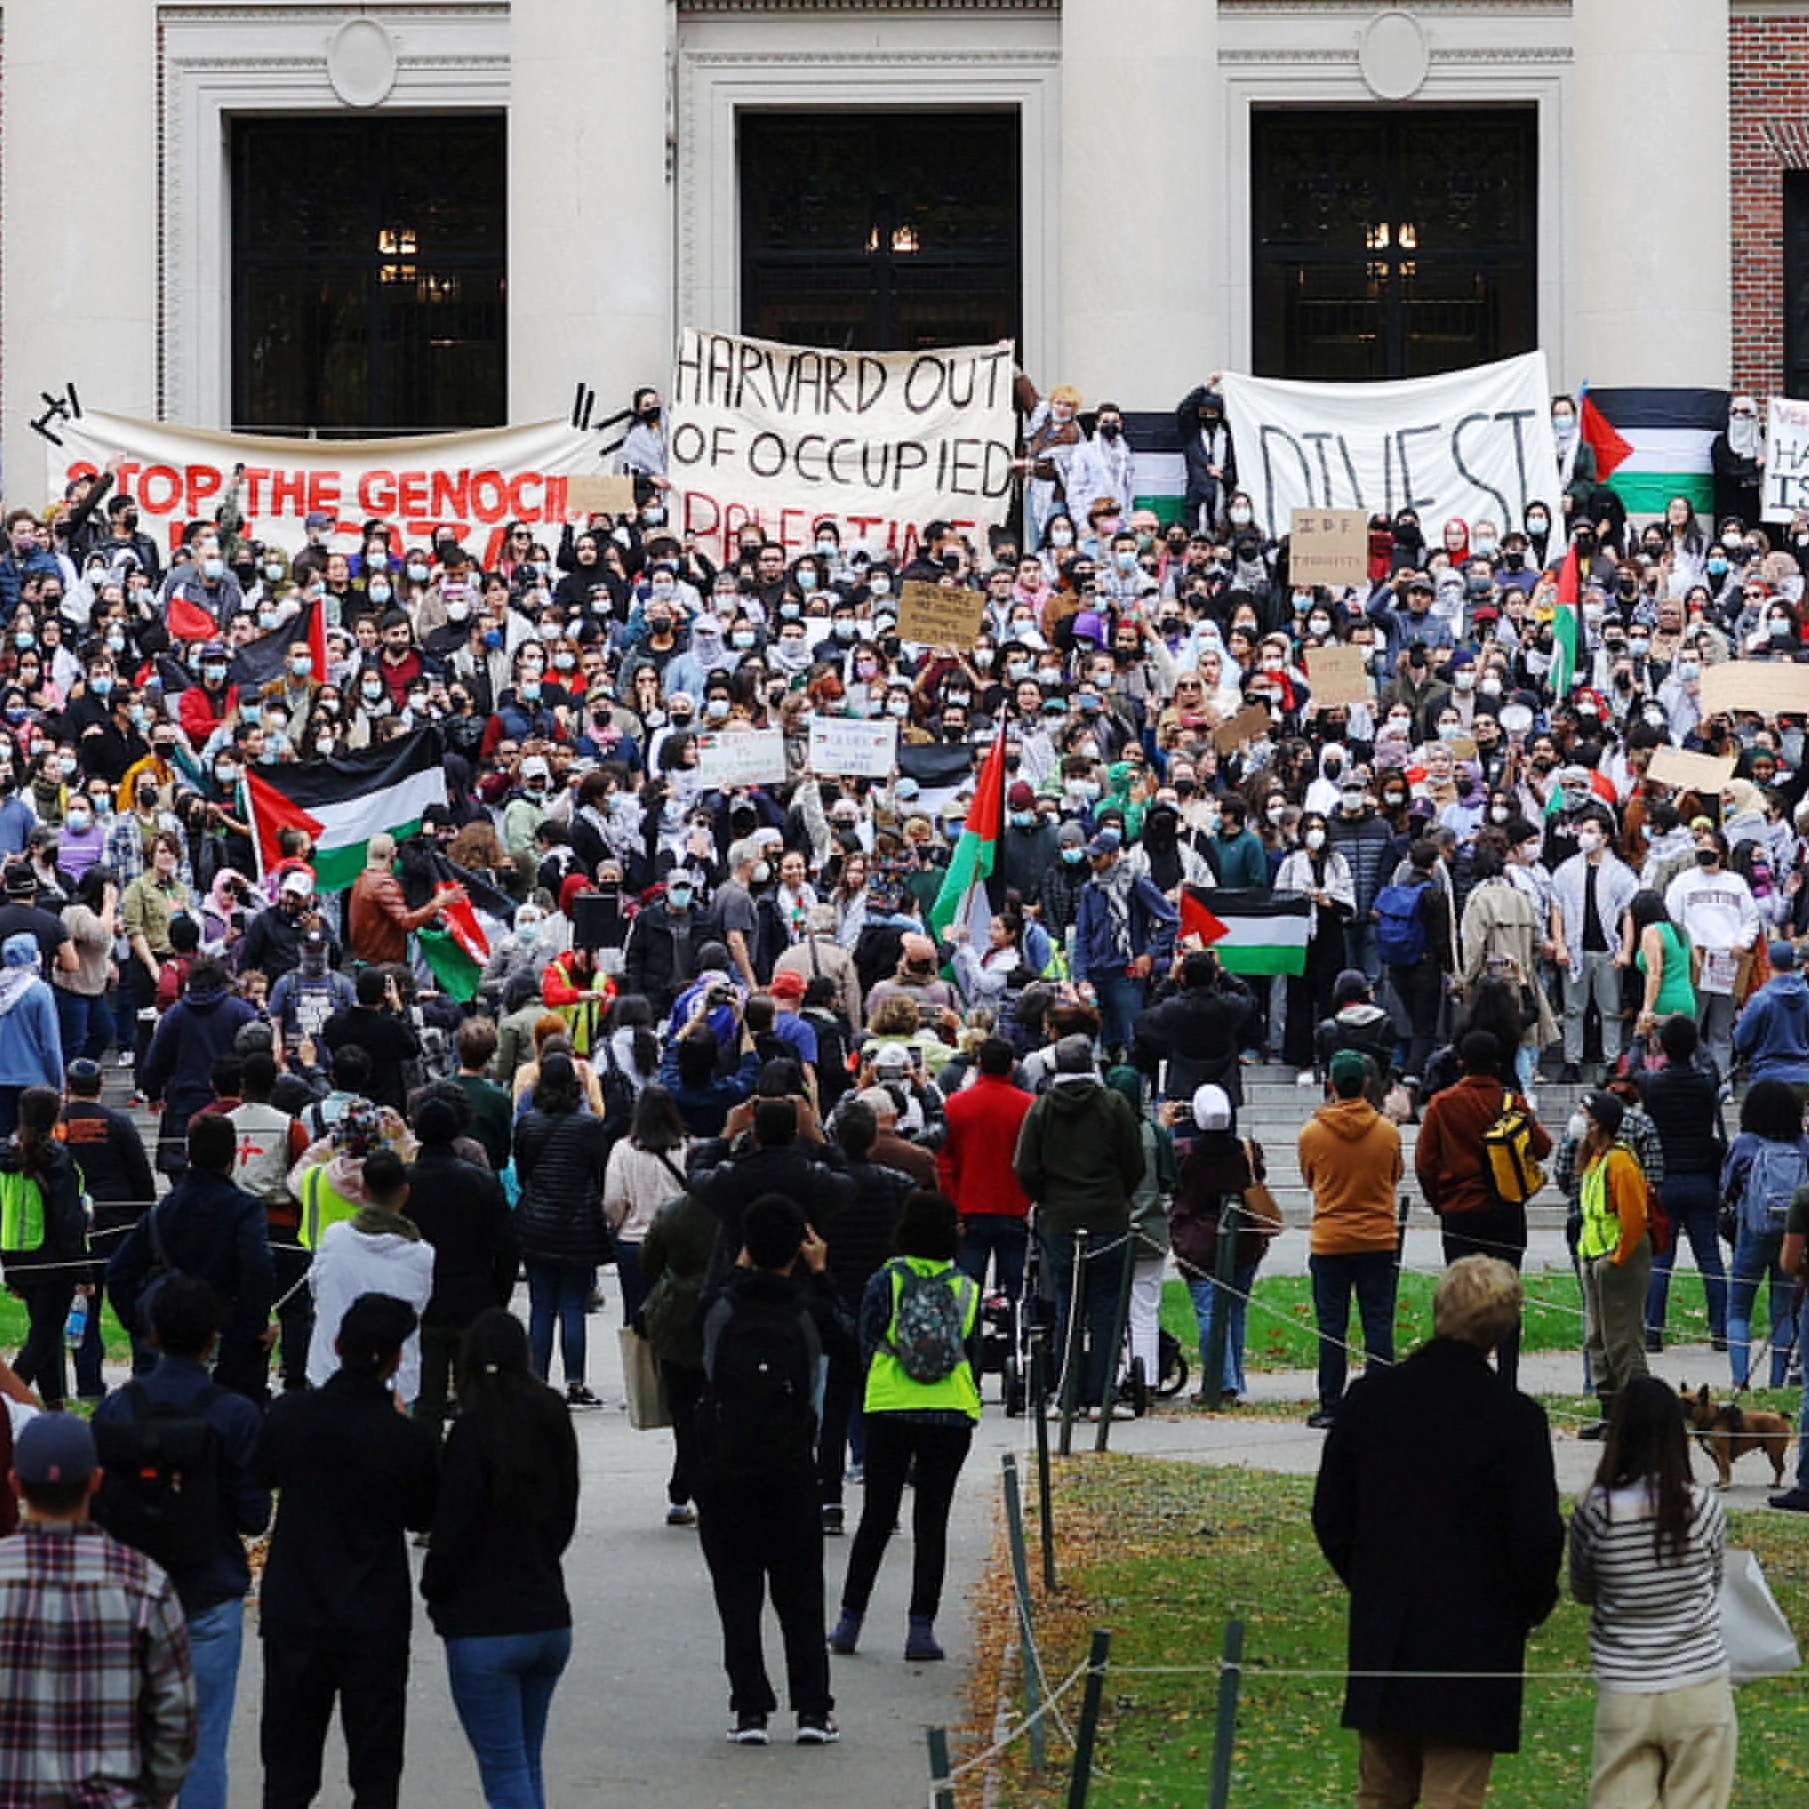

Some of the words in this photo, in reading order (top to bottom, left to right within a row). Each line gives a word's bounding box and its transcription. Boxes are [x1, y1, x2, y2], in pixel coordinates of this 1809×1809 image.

[677, 333, 889, 414] HARVARD
[904, 351, 1012, 414] OUT
[237, 466, 342, 519] THE
[358, 468, 593, 525] GENOCI
[672, 422, 736, 467] OF
[749, 431, 1012, 498] OCCUPIED
[1260, 408, 1536, 544] DIVEST
[685, 492, 976, 569] PAETIN
